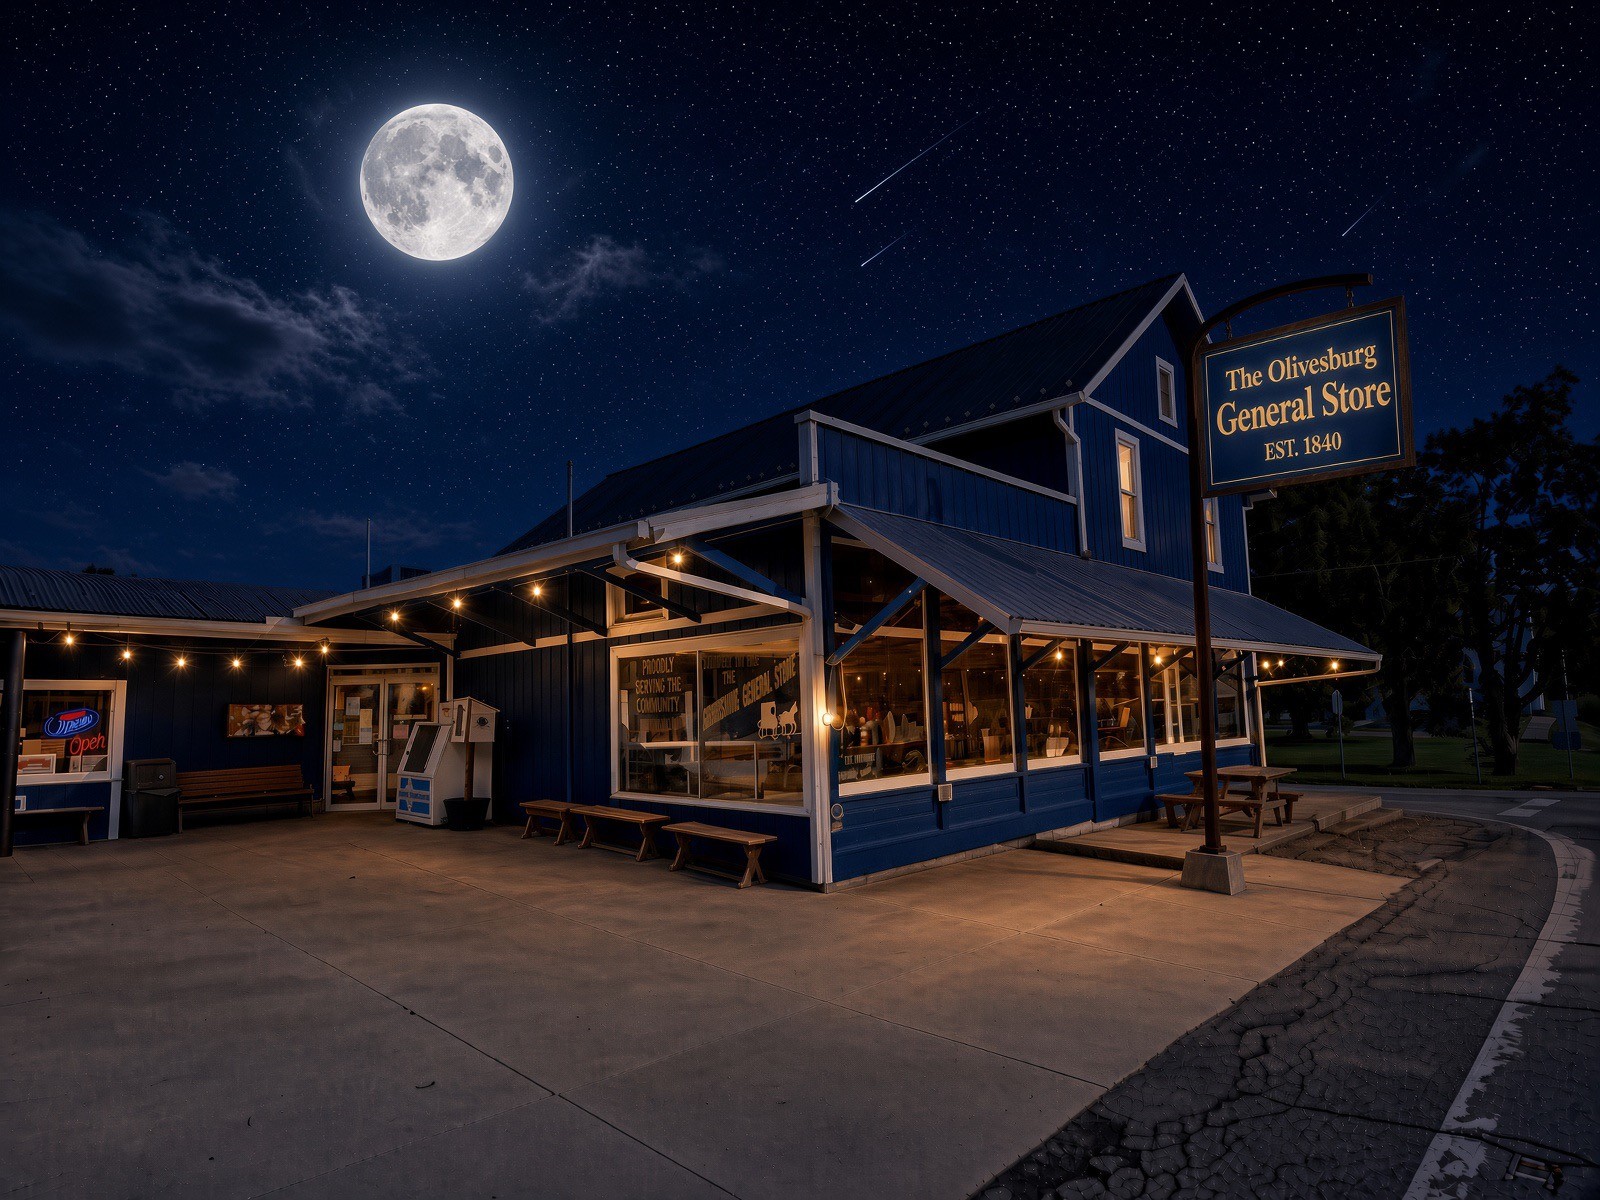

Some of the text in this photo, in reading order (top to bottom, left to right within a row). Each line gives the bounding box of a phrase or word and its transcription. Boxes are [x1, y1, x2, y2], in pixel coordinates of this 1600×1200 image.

[1225, 344, 1378, 392] The Olivesburg
[1216, 380, 1392, 437] General Store
[1264, 431, 1342, 462] EST. 1840
[667, 676, 682, 693] THE
[722, 669, 736, 686] THE
[636, 696, 680, 714] COMMUNITY
